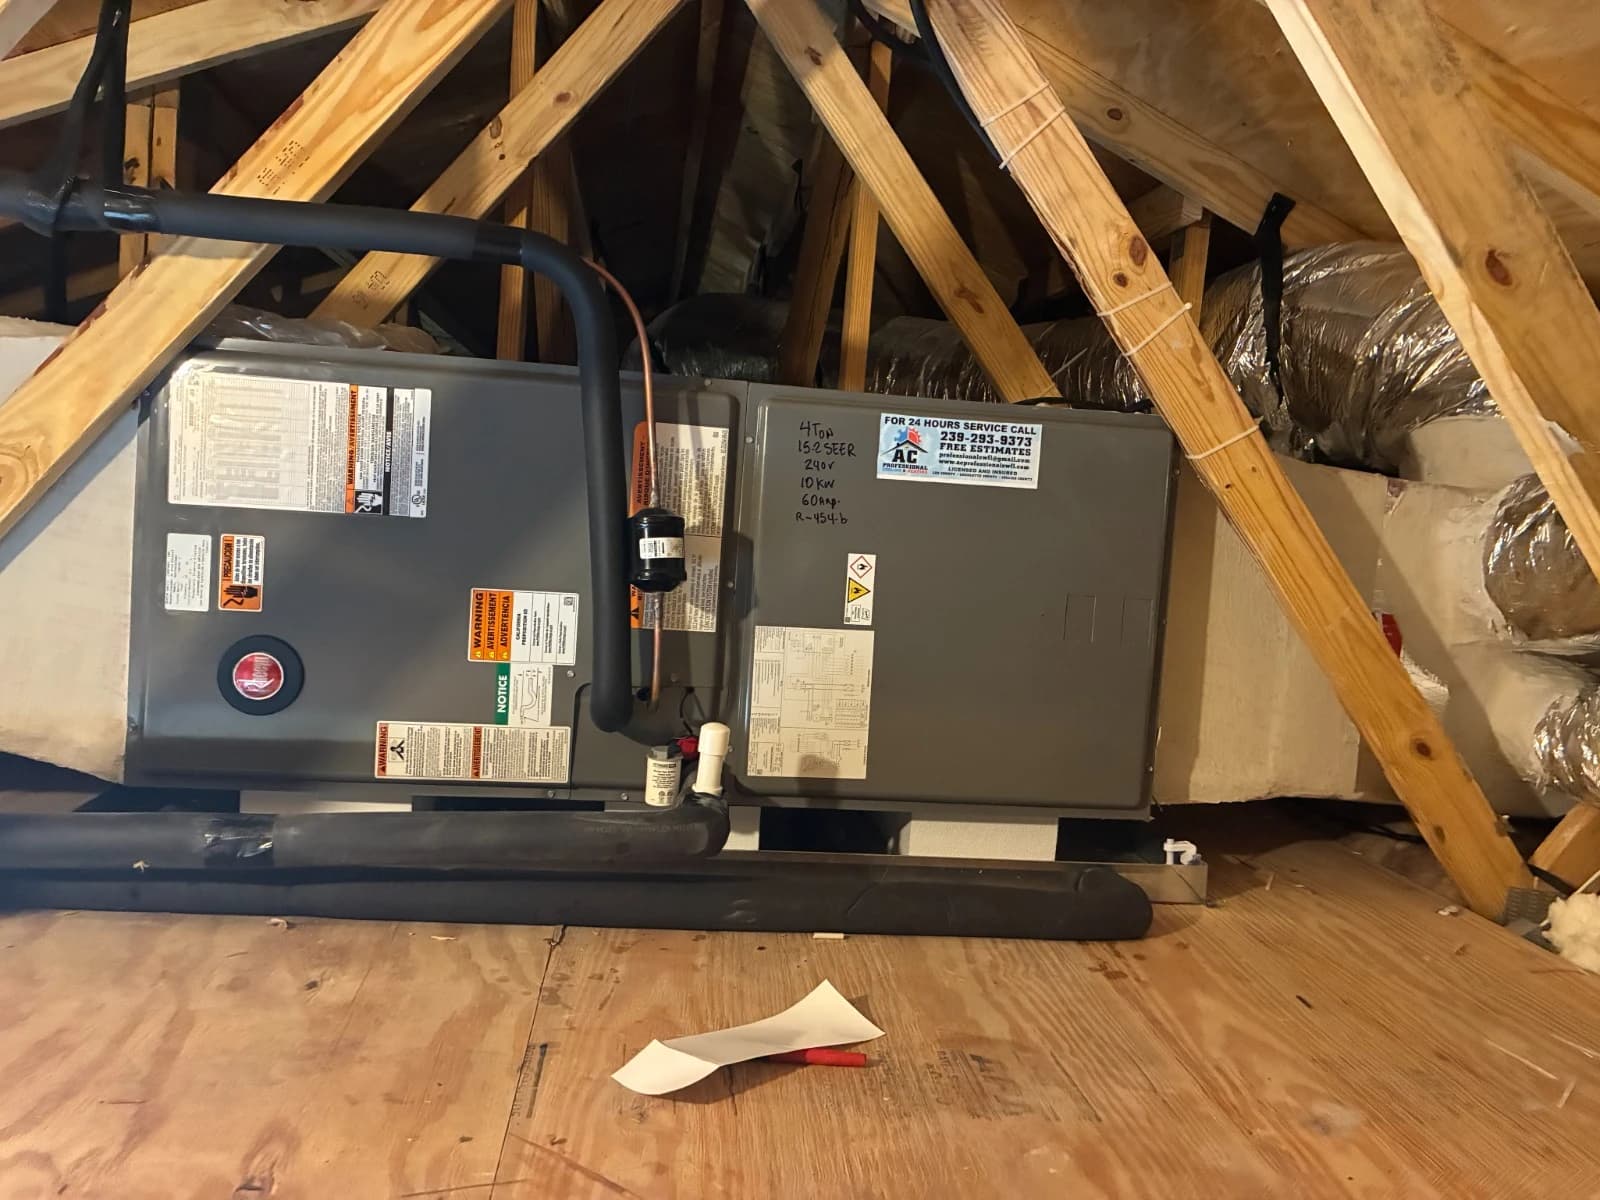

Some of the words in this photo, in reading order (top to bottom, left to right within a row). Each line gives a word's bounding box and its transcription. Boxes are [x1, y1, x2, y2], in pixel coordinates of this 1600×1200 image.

[884, 416, 905, 426] FOR
[908, 418, 921, 426] 24
[924, 419, 960, 430] HOURS
[963, 422, 1008, 433] SERVICE
[1011, 426, 1037, 435] CALL
[940, 431, 1032, 447] 239-293-9373
[824, 442, 856, 457] SEER
[892, 449, 917, 463] AC
[939, 442, 967, 452] FREE
[970, 445, 1031, 456] ESTIMATES
[801, 476, 814, 488] 10
[474, 592, 484, 648] WARNING
[486, 593, 497, 650] AVERTISSEMENT
[500, 595, 511, 648] ADVERTENCIA
[497, 675, 508, 713] NOTICE
[378, 727, 387, 766] WARNING
